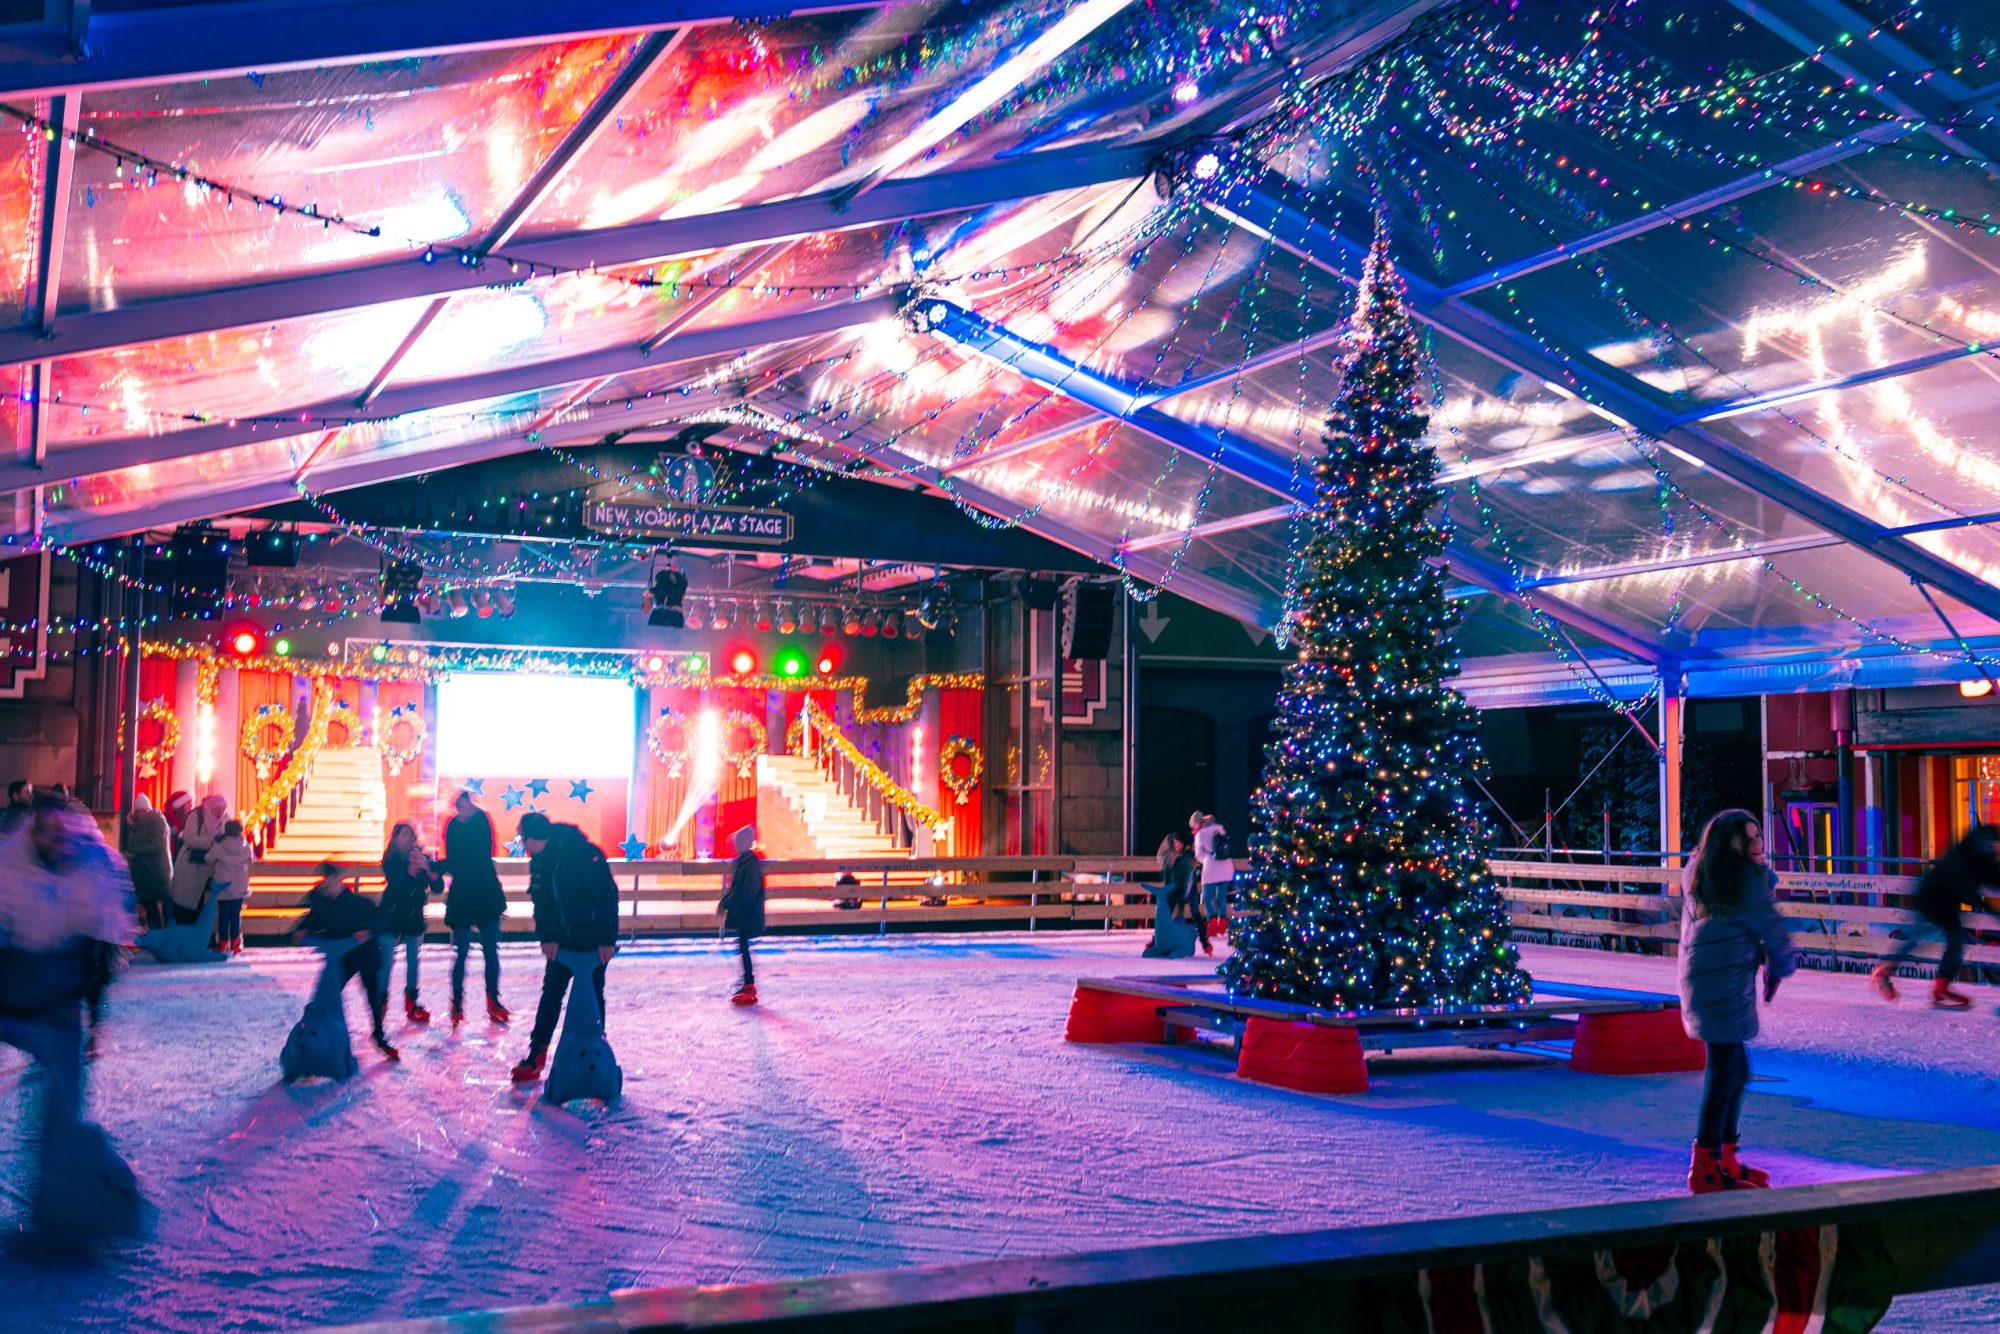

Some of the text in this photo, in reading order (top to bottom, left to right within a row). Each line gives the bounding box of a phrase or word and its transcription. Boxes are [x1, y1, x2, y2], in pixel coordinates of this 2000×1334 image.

[594, 506, 629, 524] NEW
[635, 508, 678, 526] YORK
[683, 513, 734, 532] PLAZA
[738, 516, 783, 535] STAGE
